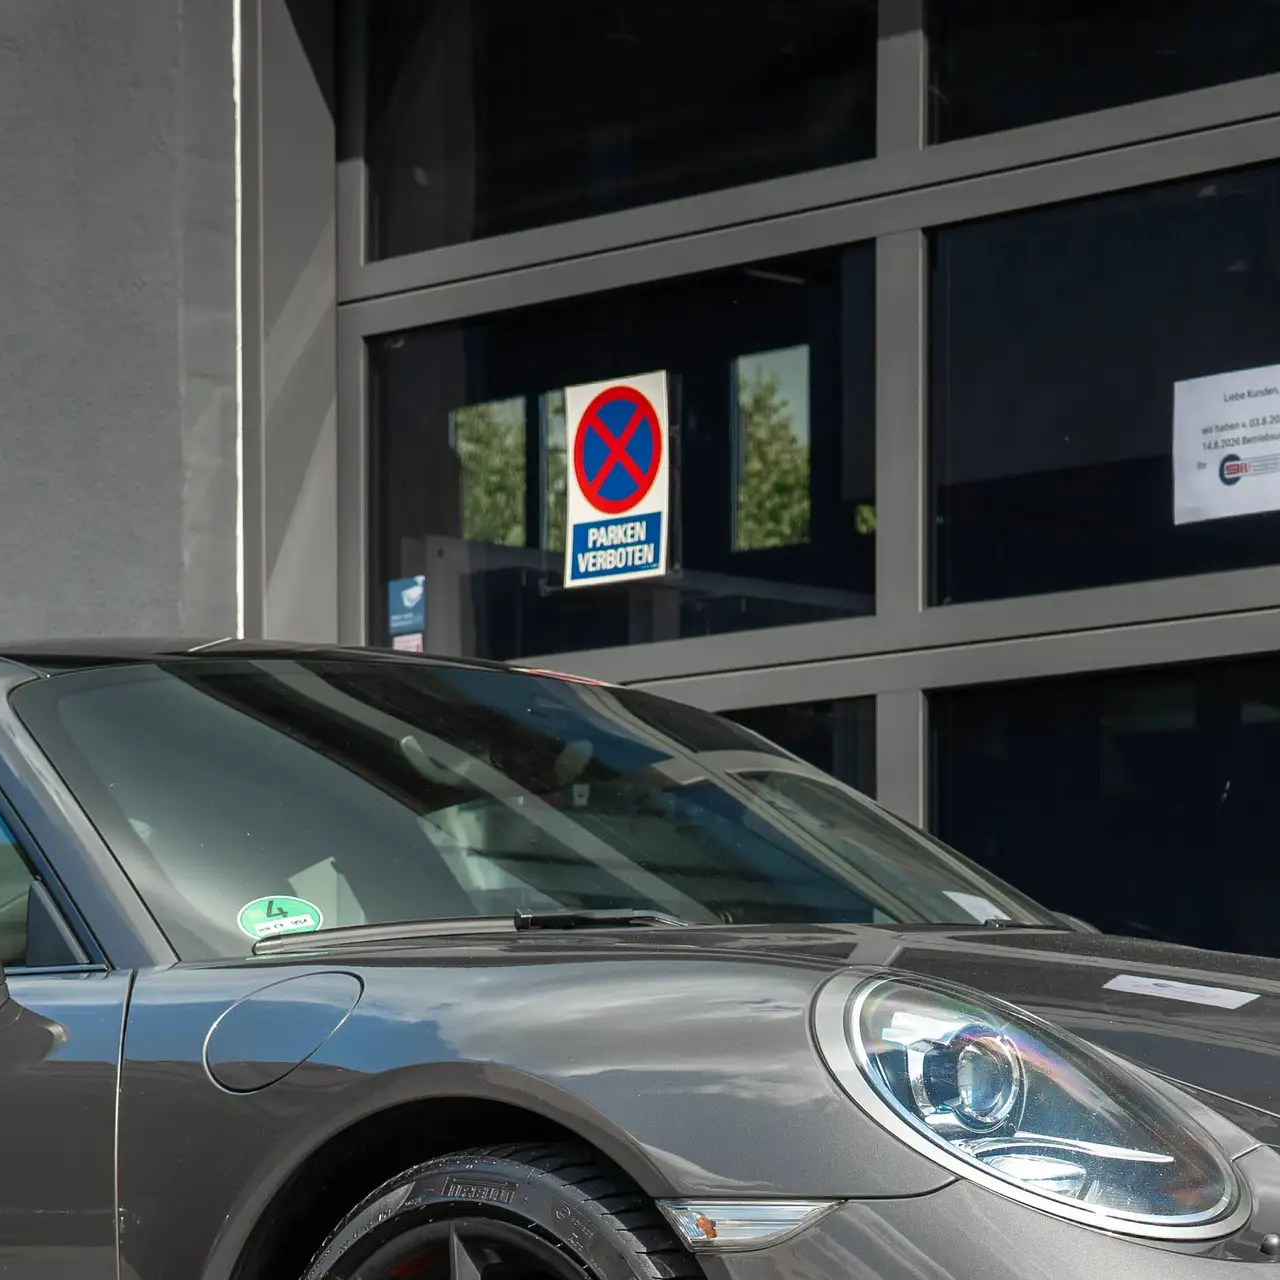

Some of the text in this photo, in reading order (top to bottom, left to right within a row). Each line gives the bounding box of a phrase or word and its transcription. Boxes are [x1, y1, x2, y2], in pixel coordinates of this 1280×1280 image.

[588, 521, 646, 548] PARKEN
[578, 544, 654, 572] VERBOTEN
[266, 899, 289, 918] 4
